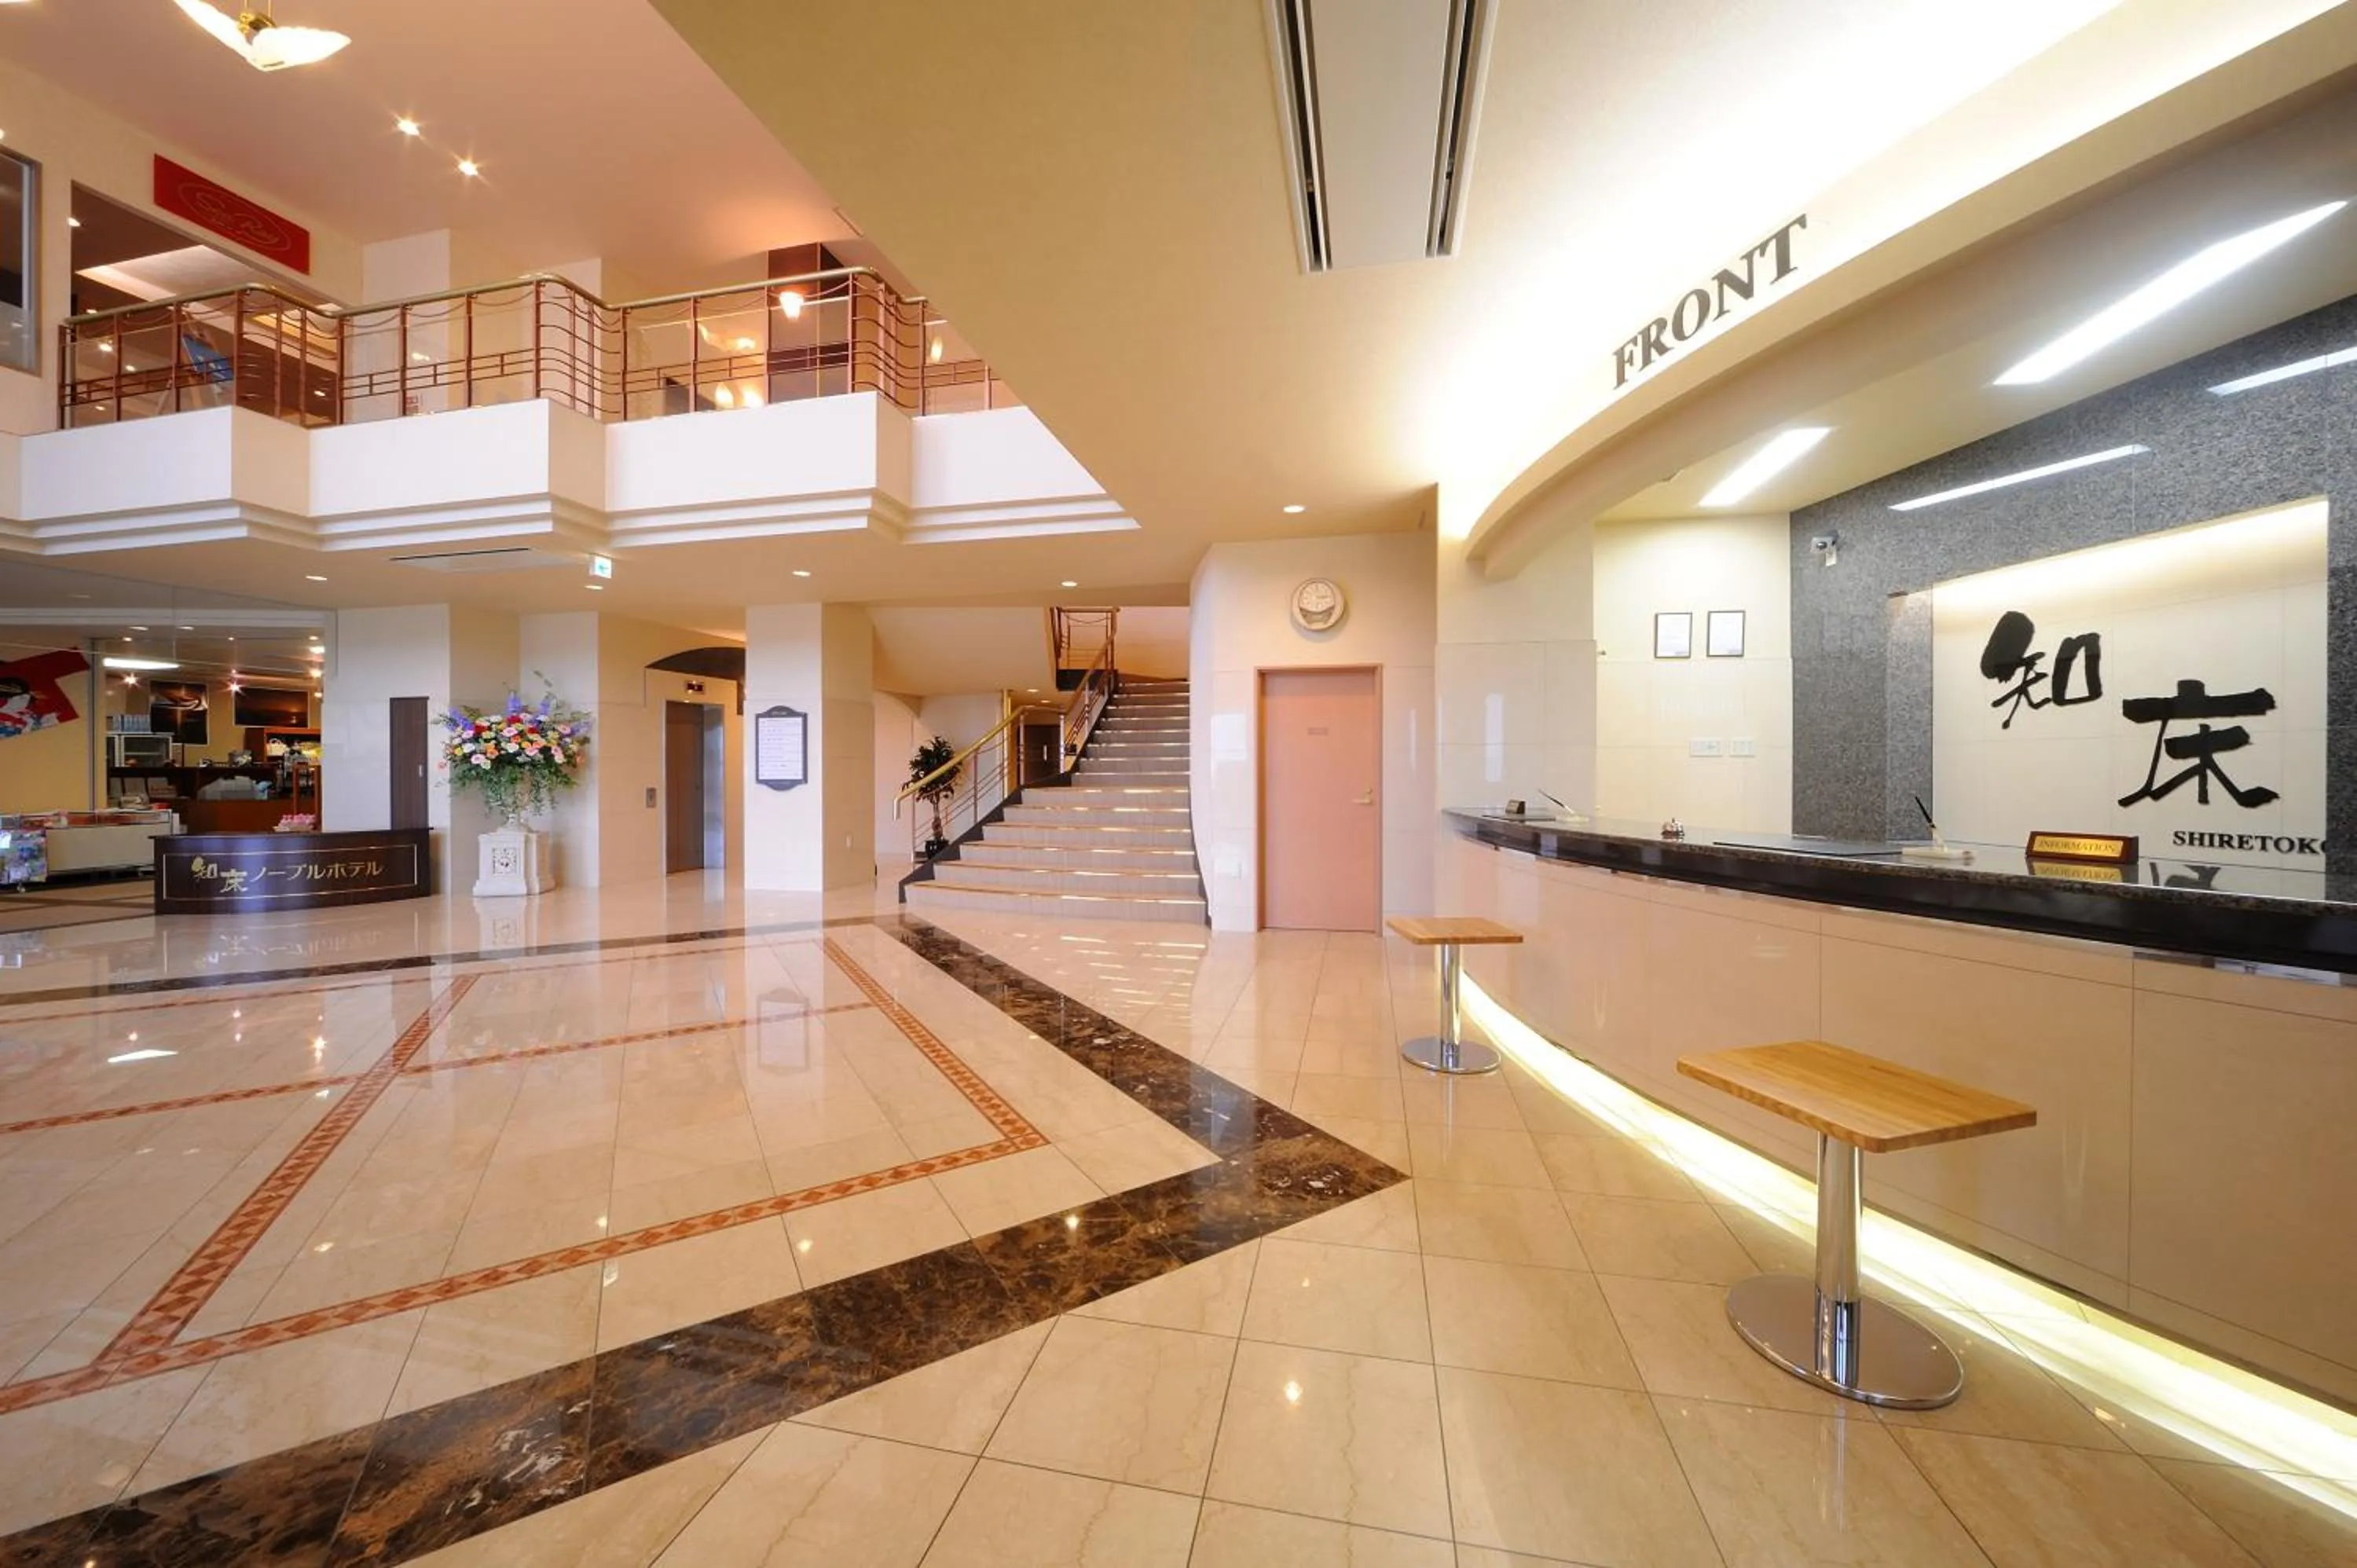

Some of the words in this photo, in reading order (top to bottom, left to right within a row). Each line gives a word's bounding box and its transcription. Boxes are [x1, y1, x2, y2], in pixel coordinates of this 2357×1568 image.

[1612, 213, 1807, 390] FRONT
[1980, 610, 2280, 808] 知床
[2039, 840, 2117, 853] INFORMATION
